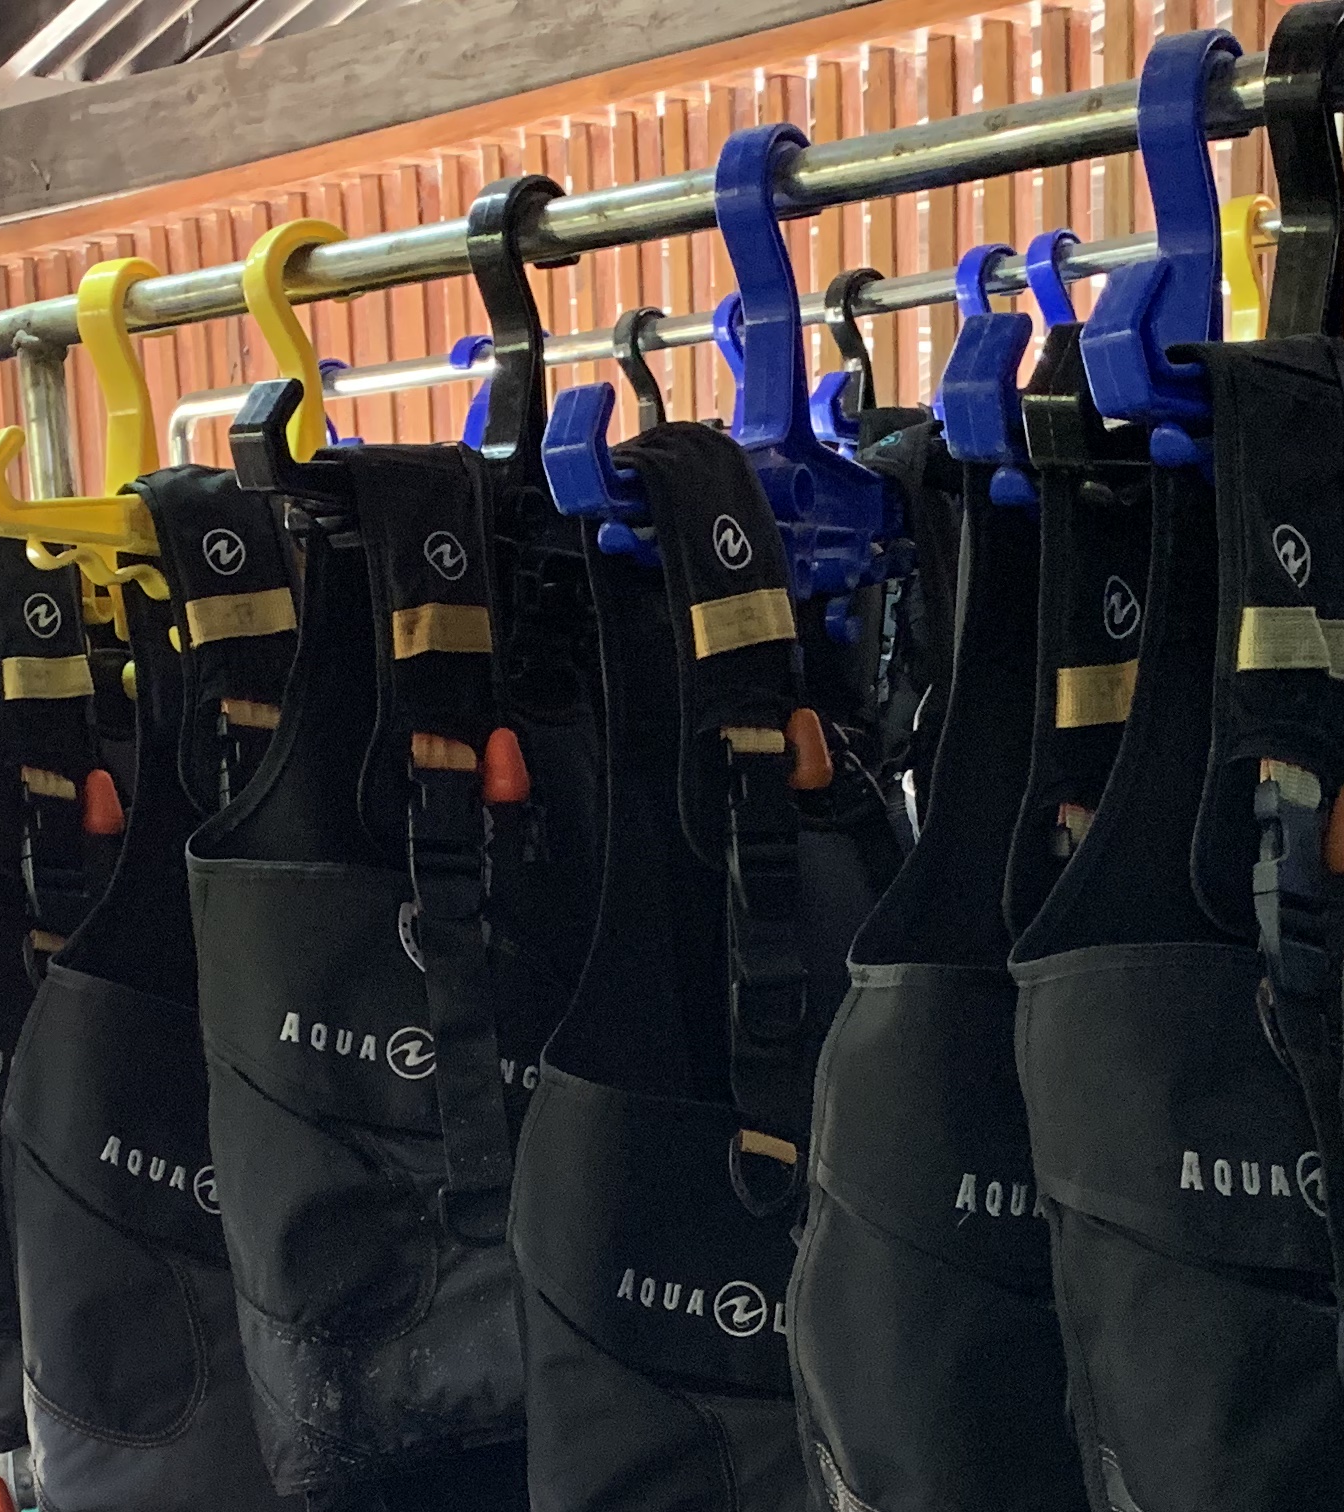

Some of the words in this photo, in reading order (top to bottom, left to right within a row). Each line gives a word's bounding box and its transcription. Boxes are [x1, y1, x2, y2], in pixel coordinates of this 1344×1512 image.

[280, 1012, 377, 1061] AQUA
[500, 1058, 539, 1090] NG
[100, 1135, 186, 1191] AQUA
[1180, 1151, 1291, 1197] AQUA
[617, 1268, 705, 1316] AQUA
